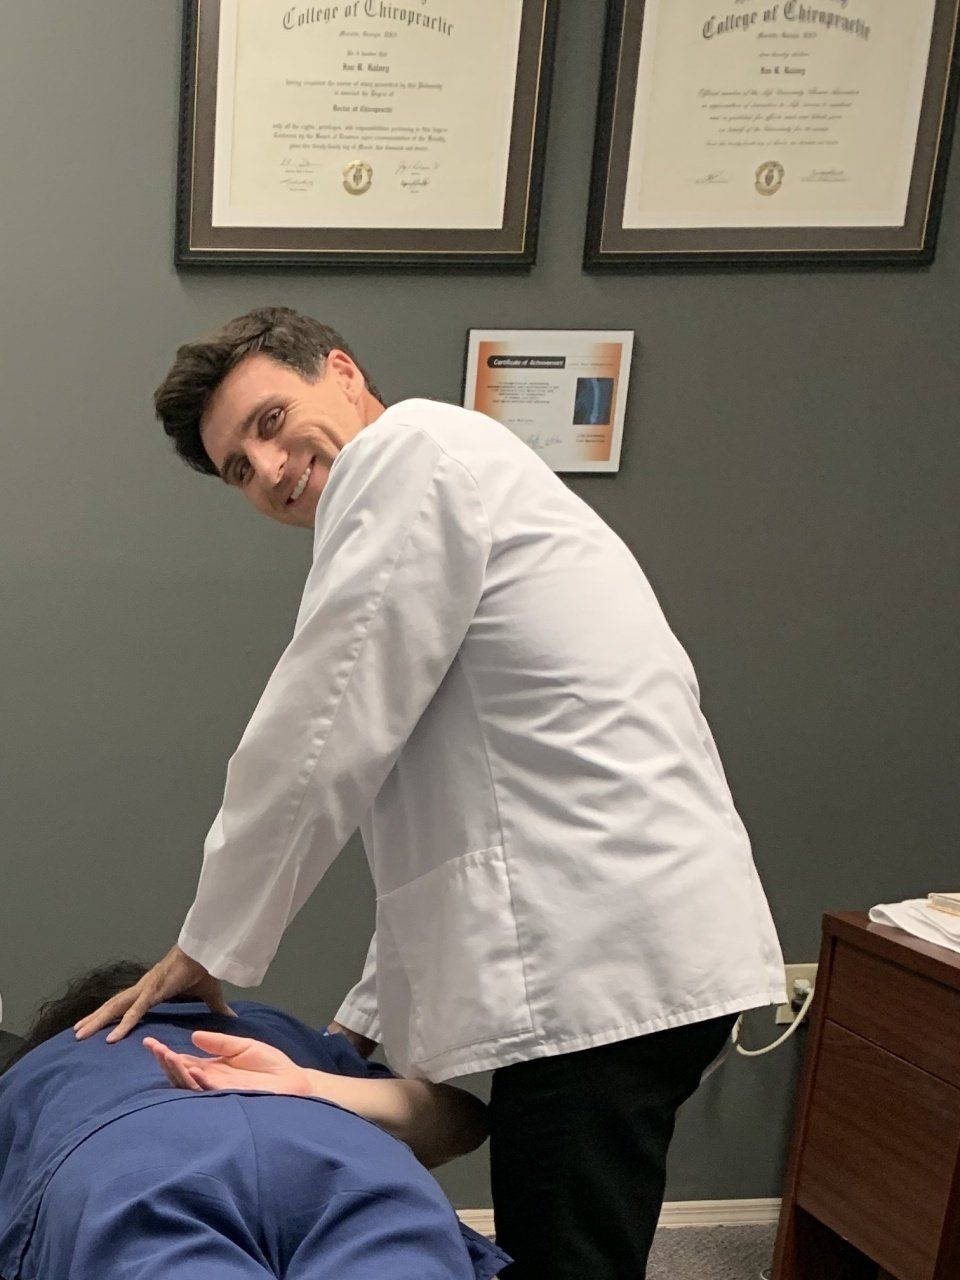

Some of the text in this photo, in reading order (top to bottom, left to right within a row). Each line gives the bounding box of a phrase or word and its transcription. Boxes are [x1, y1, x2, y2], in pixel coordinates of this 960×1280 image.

[283, 0, 455, 36] College of Chiropractic
[702, 0, 871, 41] College of Chiropractic
[493, 358, 522, 367] Certificate
[522, 359, 528, 367] of
[529, 359, 565, 367] Achievement
